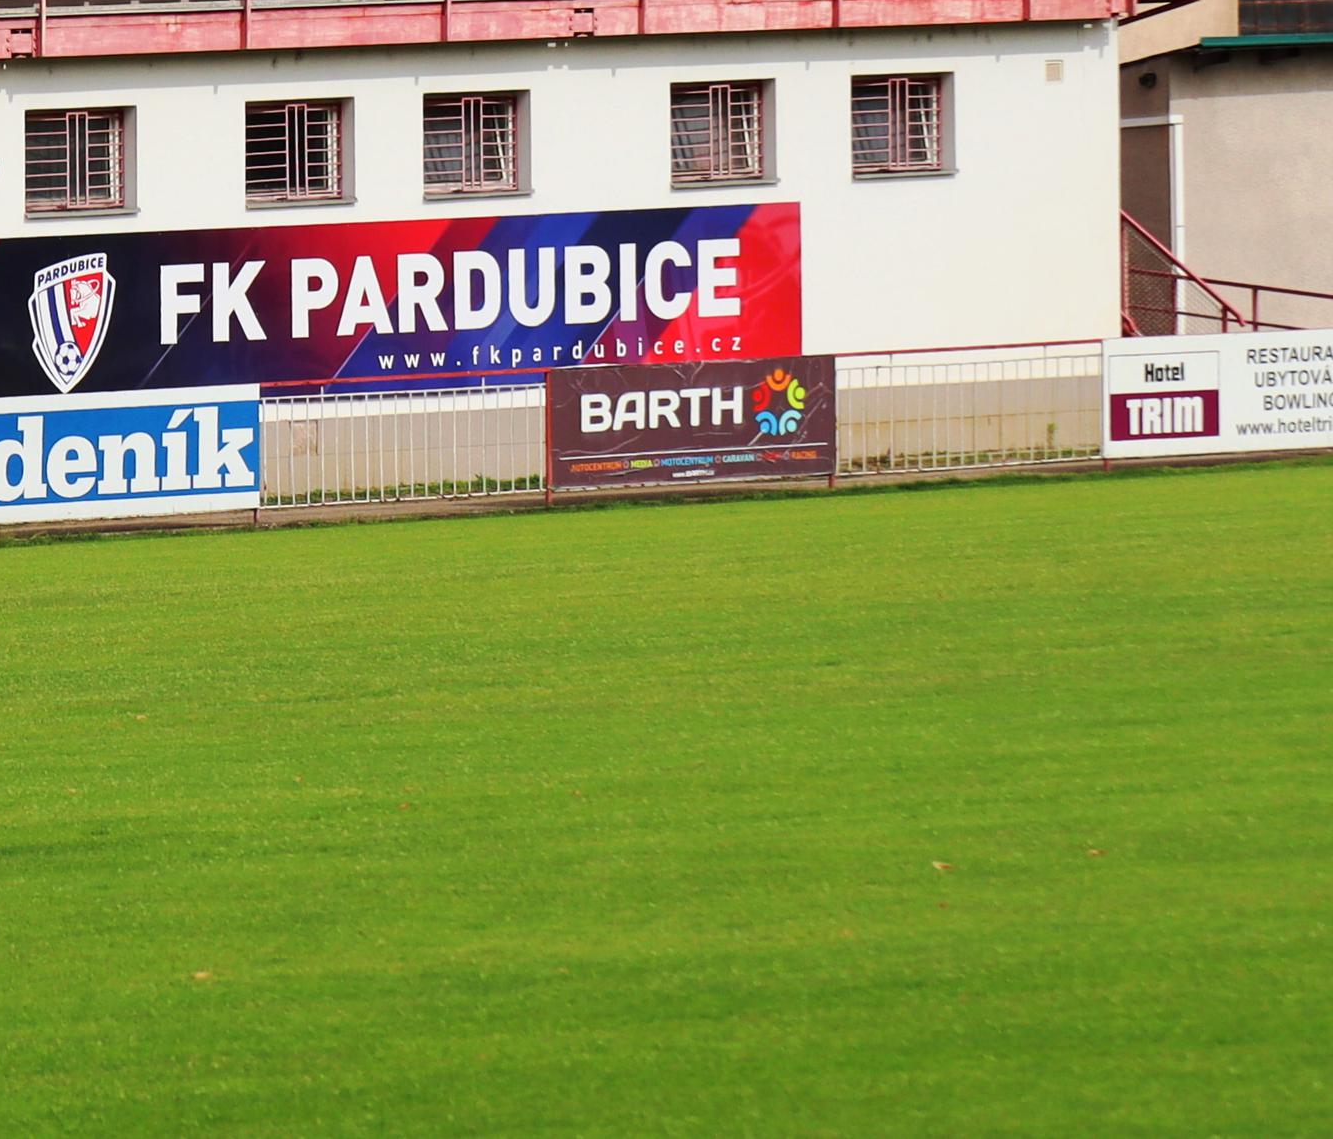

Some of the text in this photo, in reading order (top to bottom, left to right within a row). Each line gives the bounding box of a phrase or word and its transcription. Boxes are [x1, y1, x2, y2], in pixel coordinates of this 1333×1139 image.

[37, 257, 103, 287] PARDUBICE
[159, 238, 742, 345] FK PARDUBICE
[377, 335, 743, 370] www.fkpardubice.cz
[1144, 362, 1185, 382] Hotel
[580, 386, 743, 433] BARTH
[1126, 396, 1204, 435] TRIM
